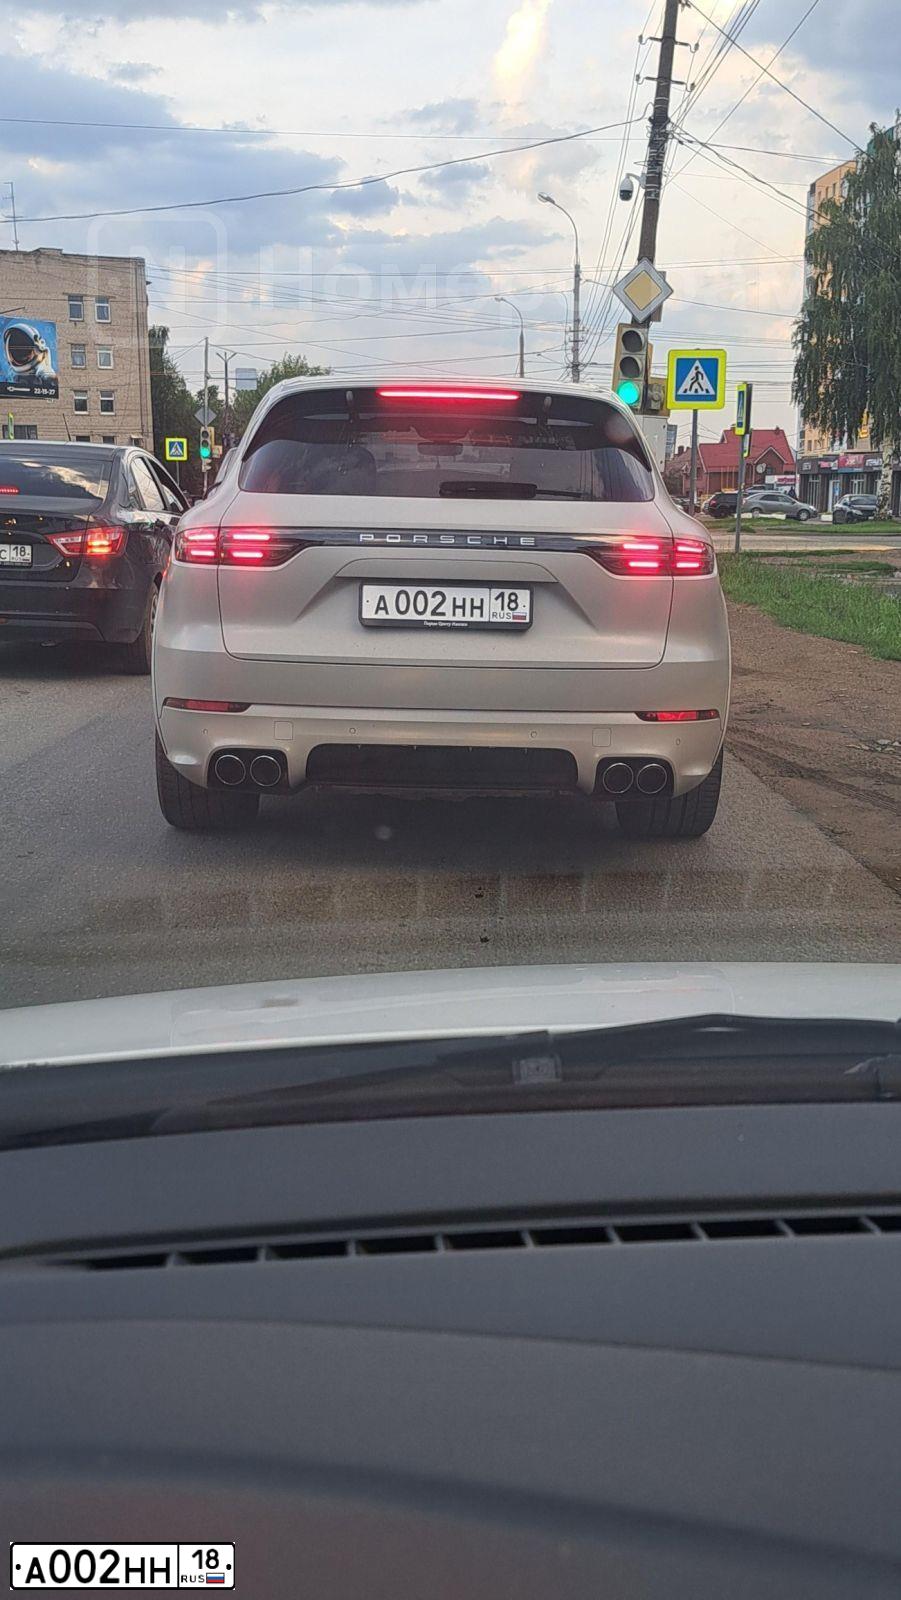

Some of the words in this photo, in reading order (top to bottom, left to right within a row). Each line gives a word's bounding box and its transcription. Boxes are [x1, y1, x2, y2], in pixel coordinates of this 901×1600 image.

[359, 533, 536, 546] PORSCHE
[12, 546, 26, 557] 18
[374, 589, 485, 618] А002НН
[494, 591, 519, 611] 18
[492, 611, 512, 620] RUS
